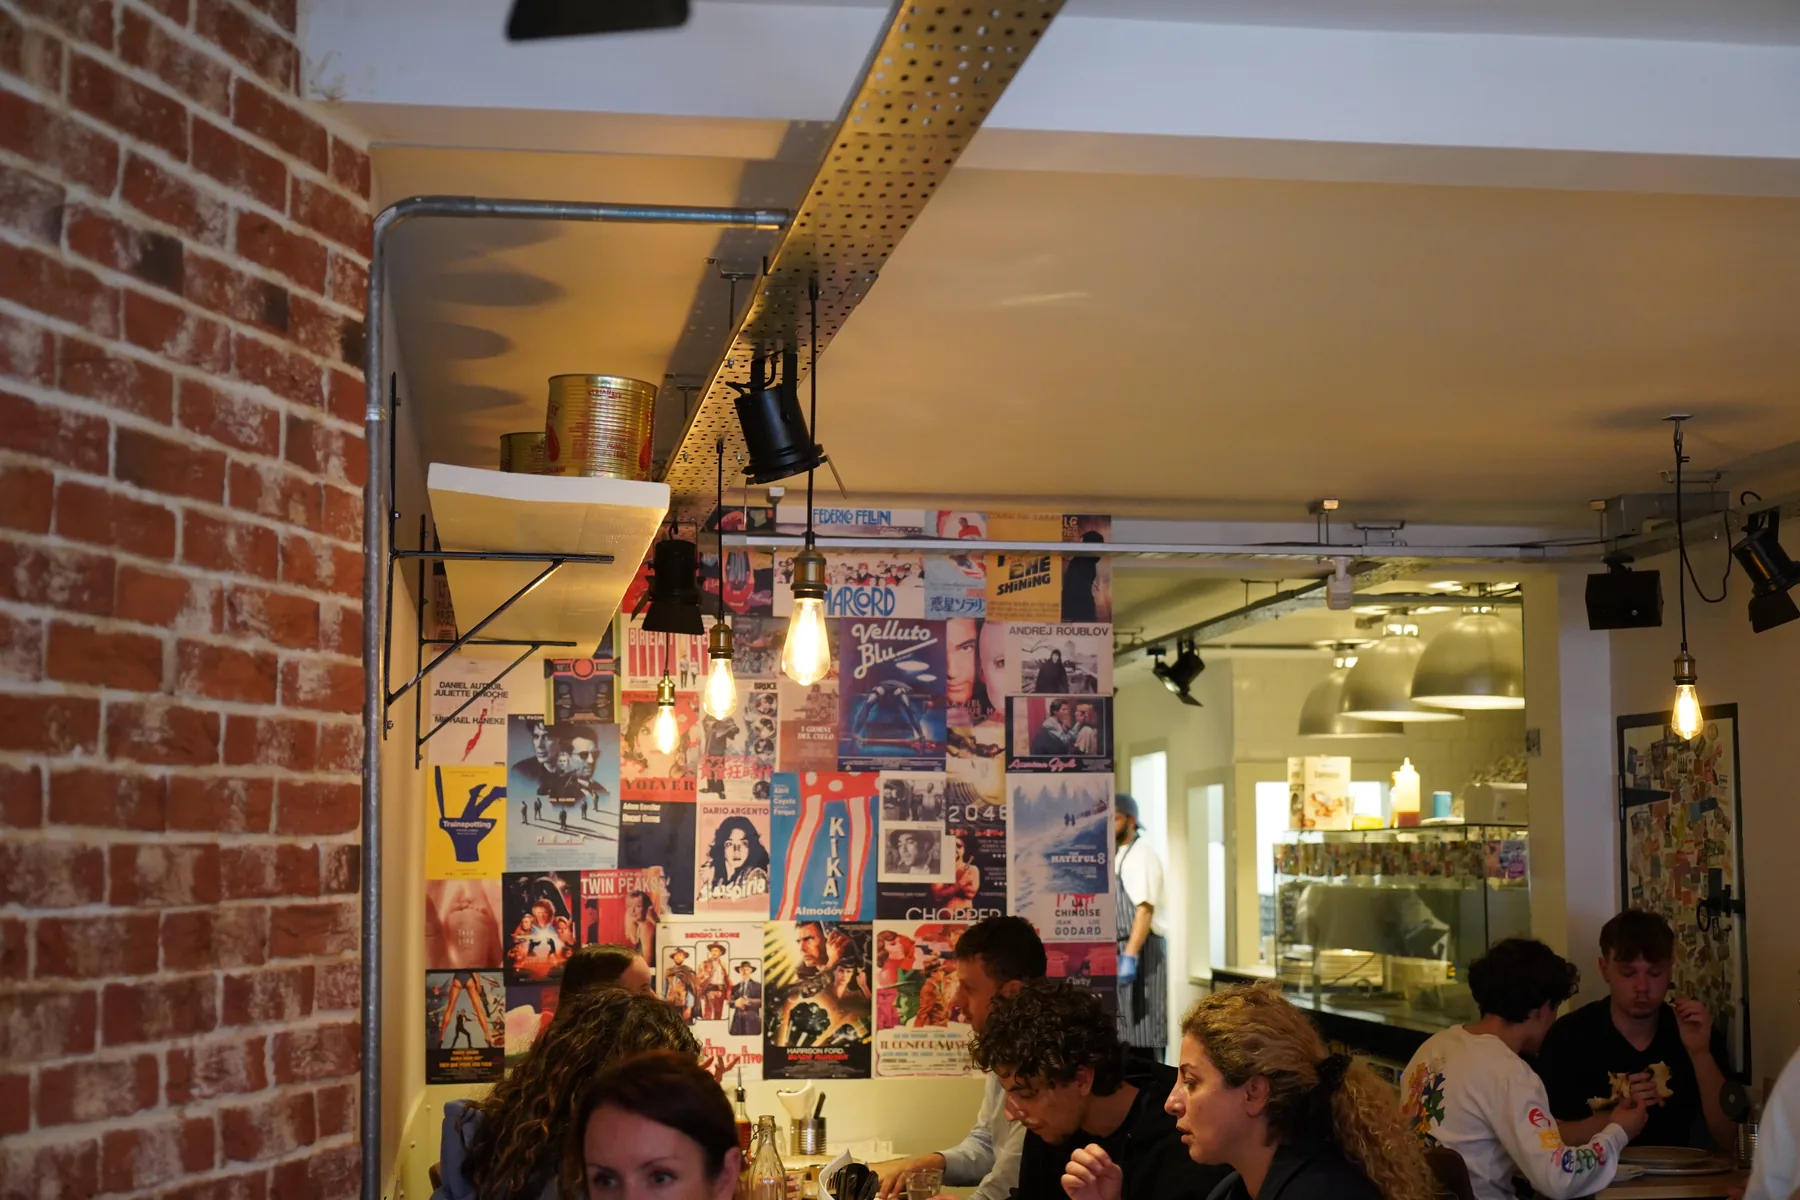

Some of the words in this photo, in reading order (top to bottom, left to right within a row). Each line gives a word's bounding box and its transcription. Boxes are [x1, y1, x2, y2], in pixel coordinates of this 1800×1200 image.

[813, 508, 853, 524] FEDERICO
[855, 510, 891, 526] FELLINI
[823, 586, 895, 617] MARCORD
[929, 595, 985, 613] 惑星ソラリ
[851, 620, 931, 644] Velluto
[1009, 626, 1052, 636] ANDREJ
[1056, 627, 1109, 637] ROUBLOV
[853, 642, 901, 679] Blu
[440, 682, 468, 690] DANIEL
[470, 682, 503, 690] AUTUIL
[434, 689, 471, 697] JULIETTE
[472, 717, 505, 725] HANEKE
[625, 780, 695, 791] VOLVER
[703, 806, 729, 815] DARIO
[730, 807, 769, 815] ARGENTO
[443, 820, 492, 829] Trainspotting
[823, 816, 845, 898] KIKA
[1051, 855, 1096, 863] HATEFUL
[1097, 853, 1106, 865] 8
[581, 878, 614, 895] TWIN
[618, 877, 660, 894] PEAKS
[1072, 899, 1083, 907] LA
[1055, 908, 1100, 917] CHINOISE
[1054, 926, 1101, 936] GODARD
[892, 1040, 969, 1050] CONFORMIST
